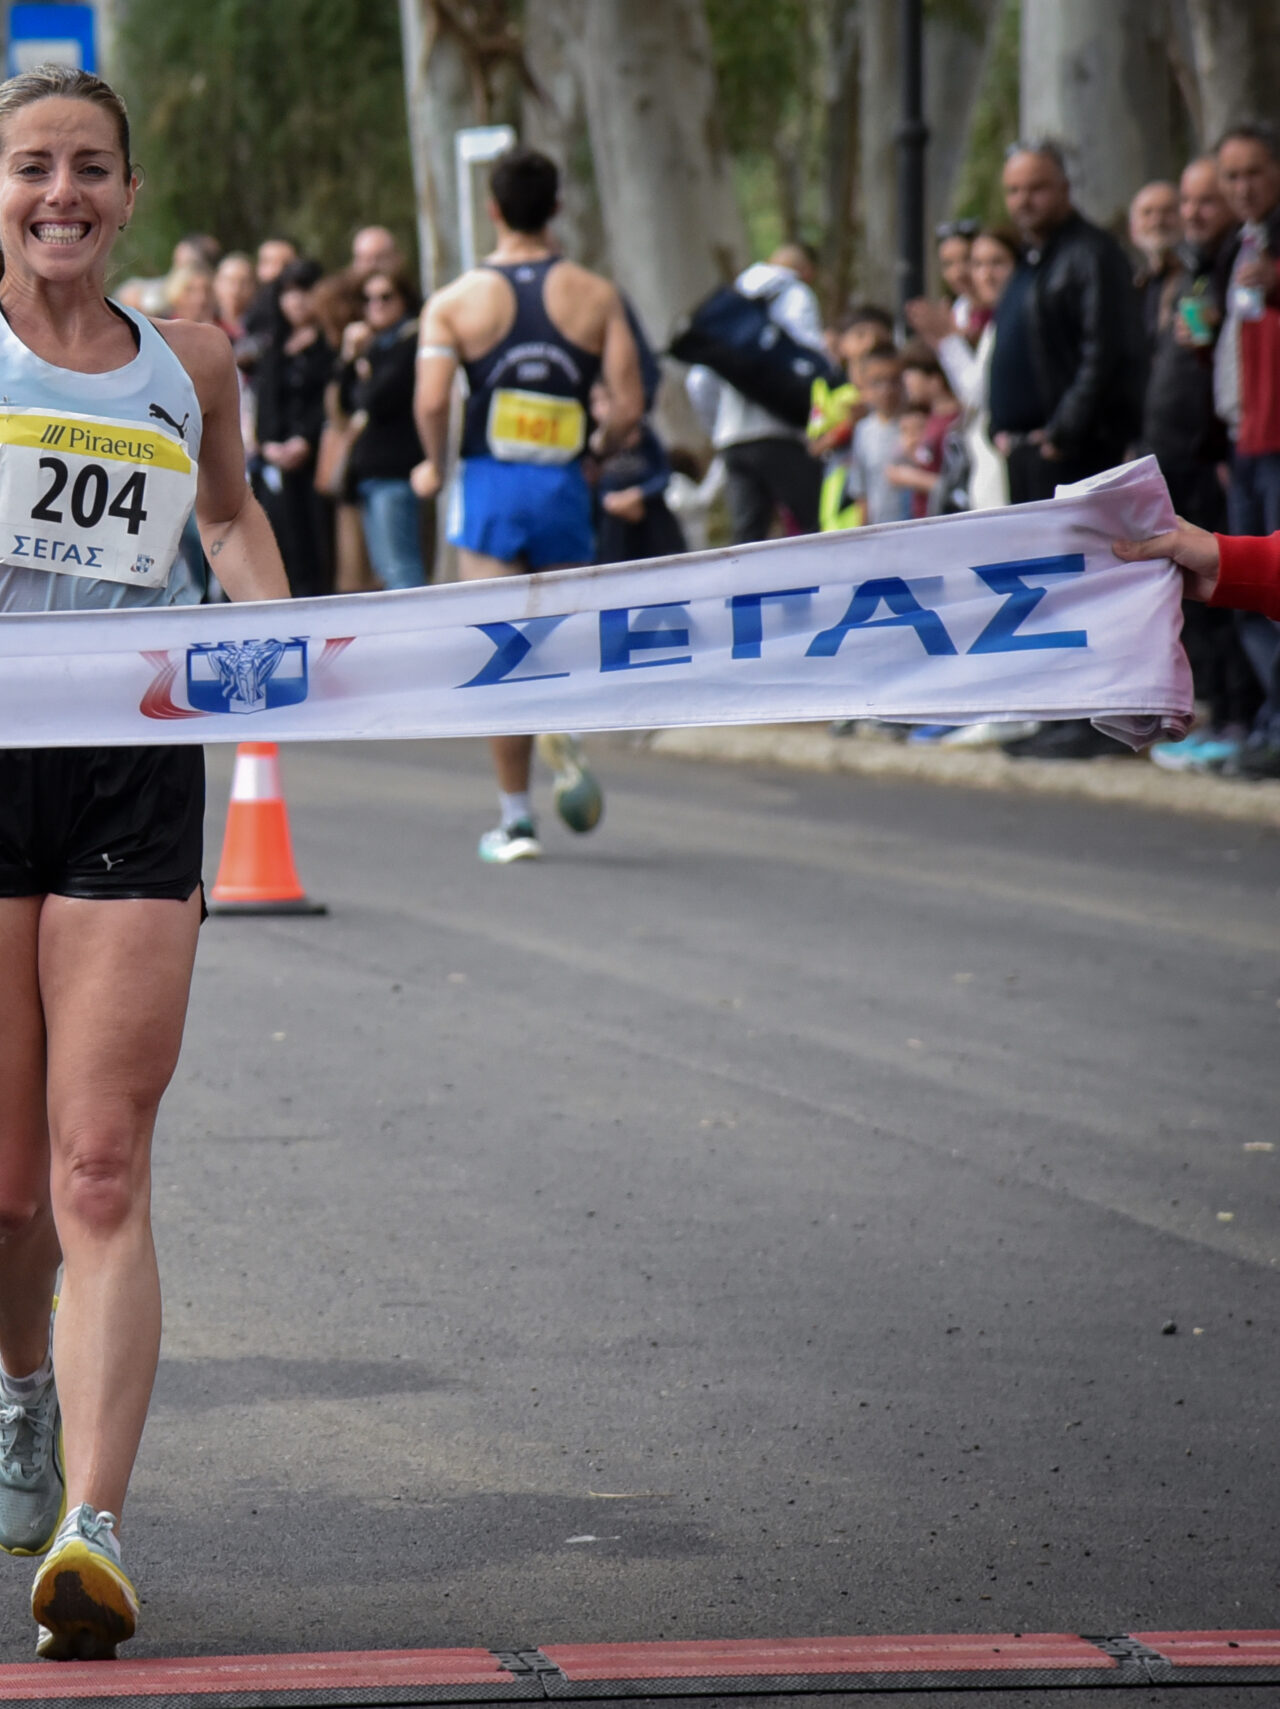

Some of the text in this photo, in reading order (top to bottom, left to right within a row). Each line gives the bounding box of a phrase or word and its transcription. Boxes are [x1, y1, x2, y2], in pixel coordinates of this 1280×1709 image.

[69, 427, 155, 461] Piraeus
[30, 456, 148, 536] 204
[10, 534, 104, 568] ΣΕΓΑΣ
[454, 553, 1088, 689] ΣΕΓΑΣ
